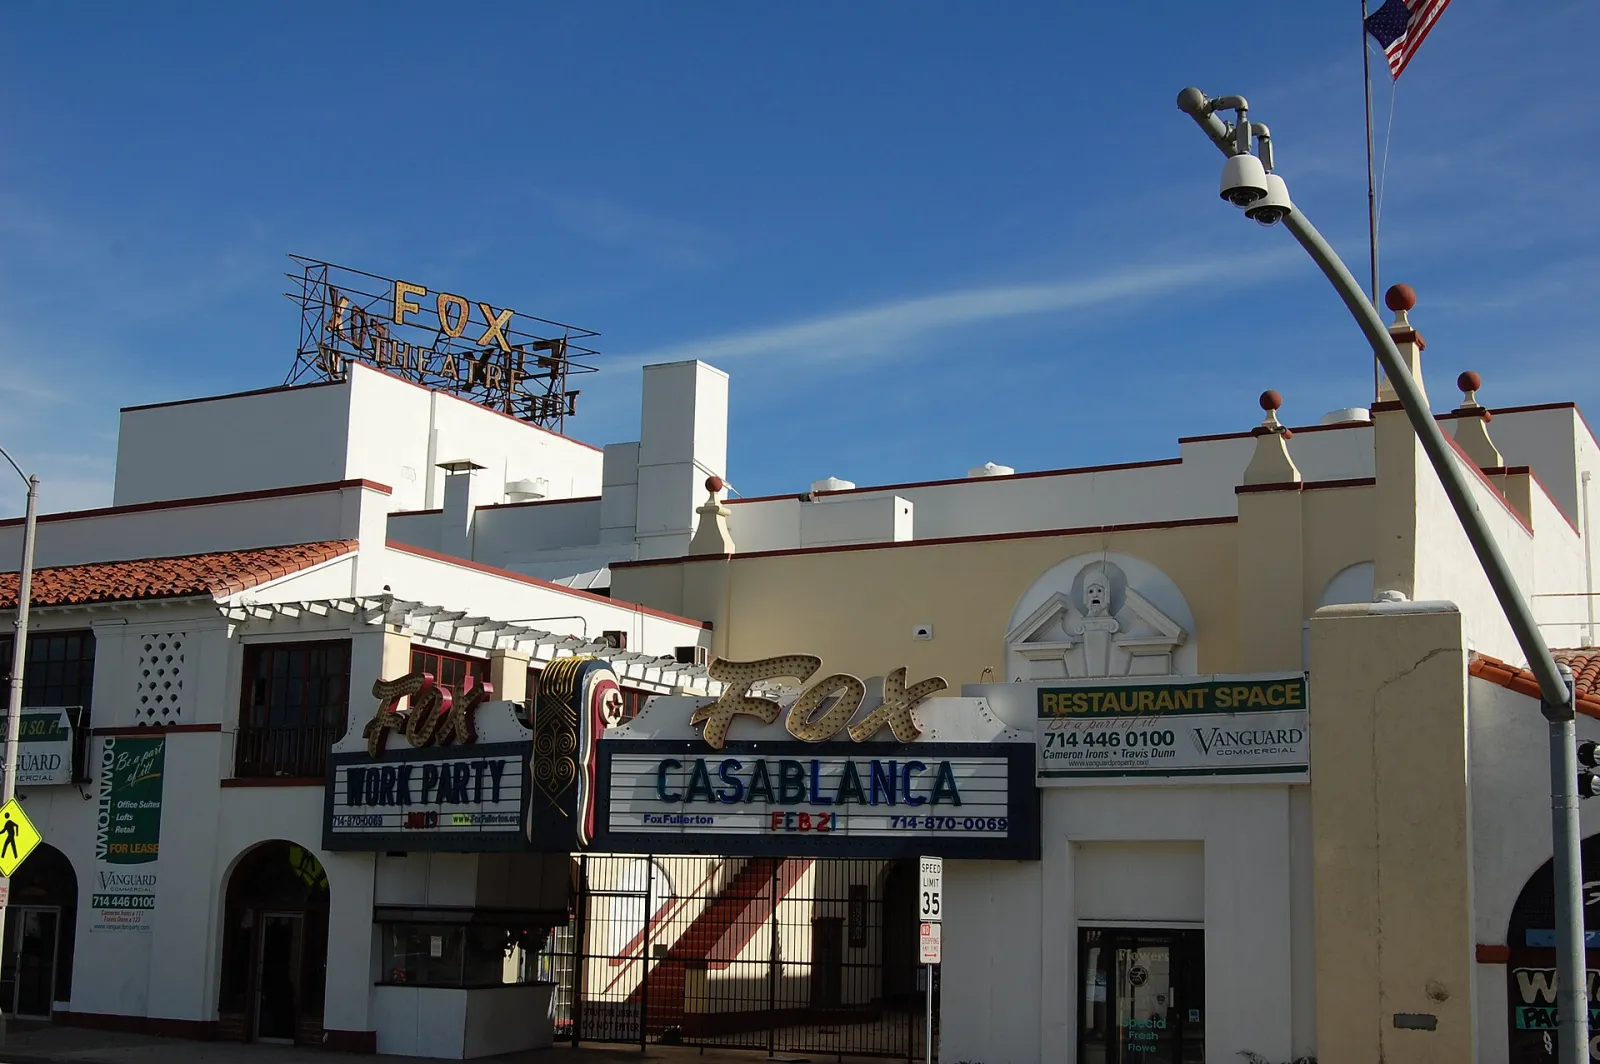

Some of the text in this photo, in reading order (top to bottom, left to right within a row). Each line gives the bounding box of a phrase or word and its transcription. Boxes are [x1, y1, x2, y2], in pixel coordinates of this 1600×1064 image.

[393, 280, 515, 353] FOX
[371, 334, 527, 397] THEATRE
[689, 653, 947, 750] Fox
[1043, 683, 1301, 713] RESTAURANT SPACE
[1044, 730, 1175, 748] 714 446 0100
[1043, 747, 1175, 760] Cameron Irons Travis Dunn
[1217, 747, 1297, 756] COMMERCIAL
[346, 760, 506, 807] WORK PARTY
[656, 758, 962, 807] CASABLANCA
[96, 736, 116, 862] DOWNTOWN
[117, 800, 161, 809] Office Suites
[115, 812, 134, 821] Lofts
[644, 811, 1008, 832] FoxFullerton FEB 21 714-870-0069
[115, 825, 136, 834] Retail
[109, 843, 159, 854] FOR LEASE
[921, 863, 941, 874] SPEED
[923, 878, 939, 887] LIMIT
[93, 896, 155, 908] 714 446 0100
[922, 891, 940, 915] 35
